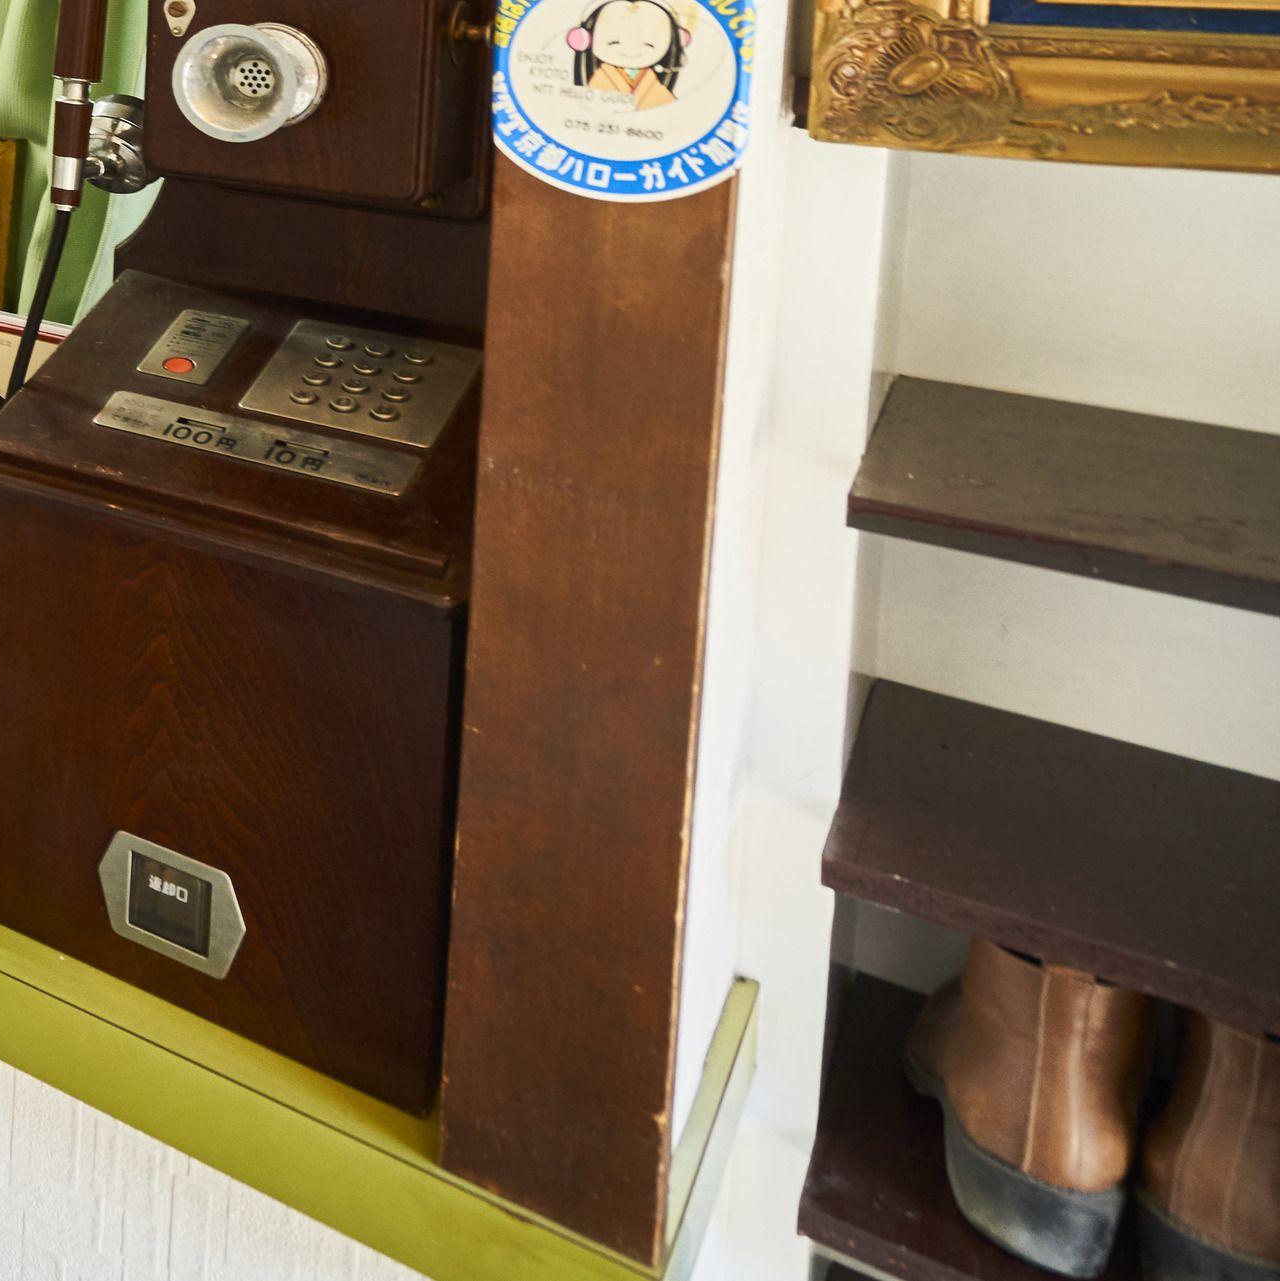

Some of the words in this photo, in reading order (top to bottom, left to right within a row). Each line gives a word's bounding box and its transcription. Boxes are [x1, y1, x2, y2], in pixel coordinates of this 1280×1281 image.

[162, 422, 238, 451] 100円
[263, 446, 325, 472] 10円
[148, 873, 189, 904] 返却口
